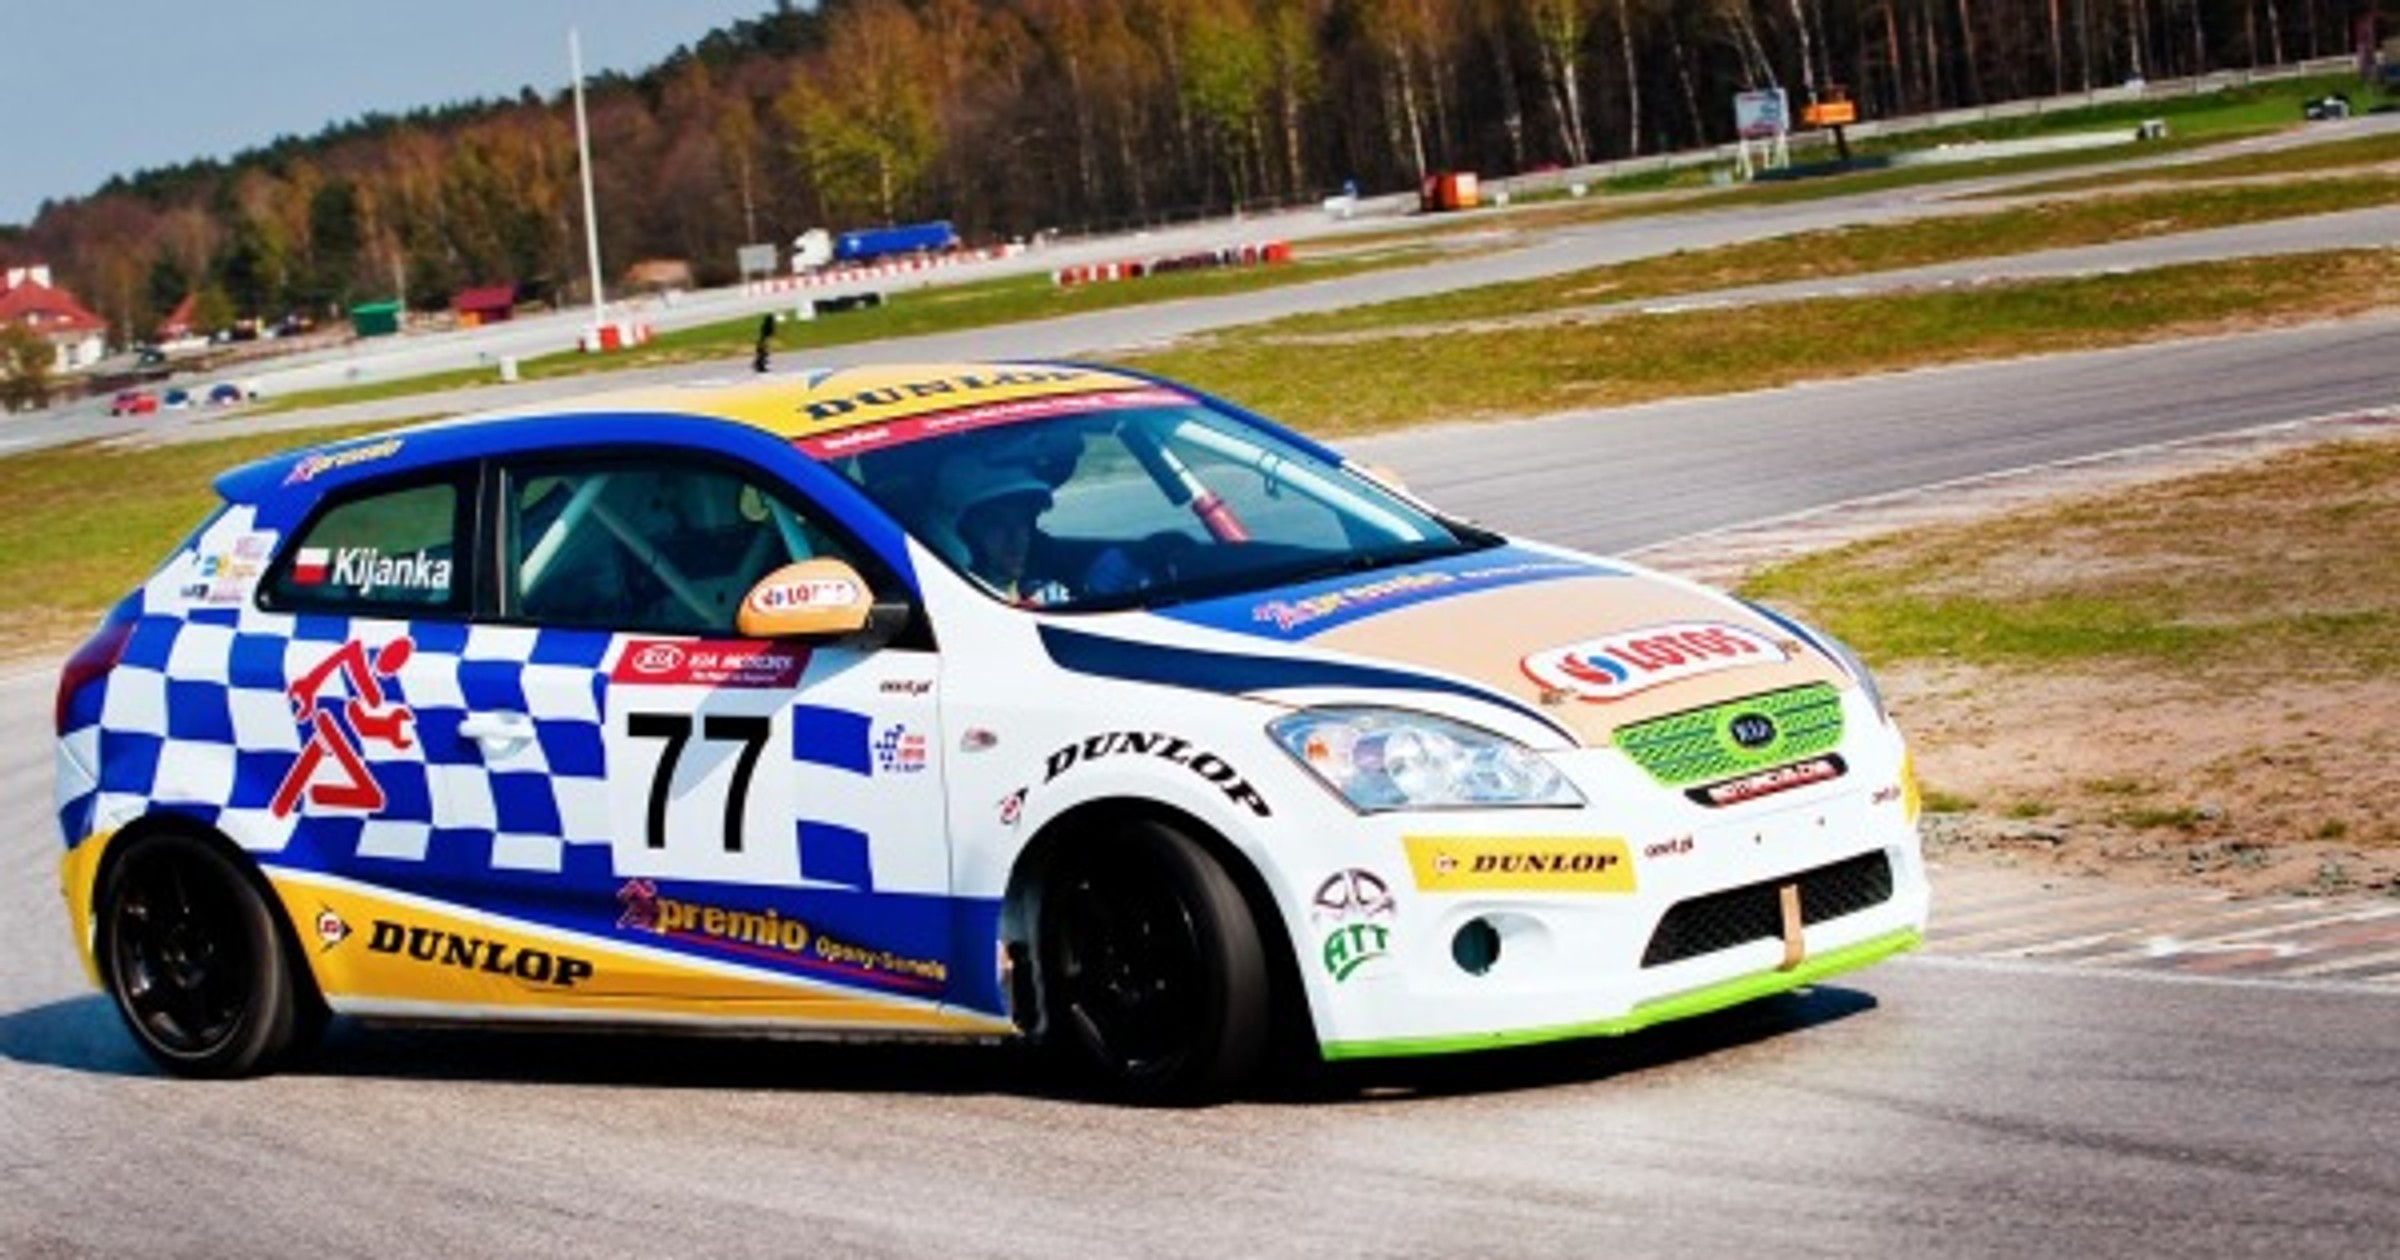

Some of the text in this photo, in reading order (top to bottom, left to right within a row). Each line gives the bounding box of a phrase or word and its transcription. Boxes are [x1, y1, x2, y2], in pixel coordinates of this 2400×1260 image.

[798, 370, 1089, 420] DUNLOP
[331, 546, 452, 596] Kijanka
[788, 583, 845, 605] LOT
[1604, 627, 1760, 673] LOTOS
[627, 712, 771, 853] 77
[1044, 732, 1272, 817] DUNLOP
[1469, 854, 1619, 873] DUNLOP
[655, 899, 807, 951] premio
[367, 920, 593, 986] DUNLOP
